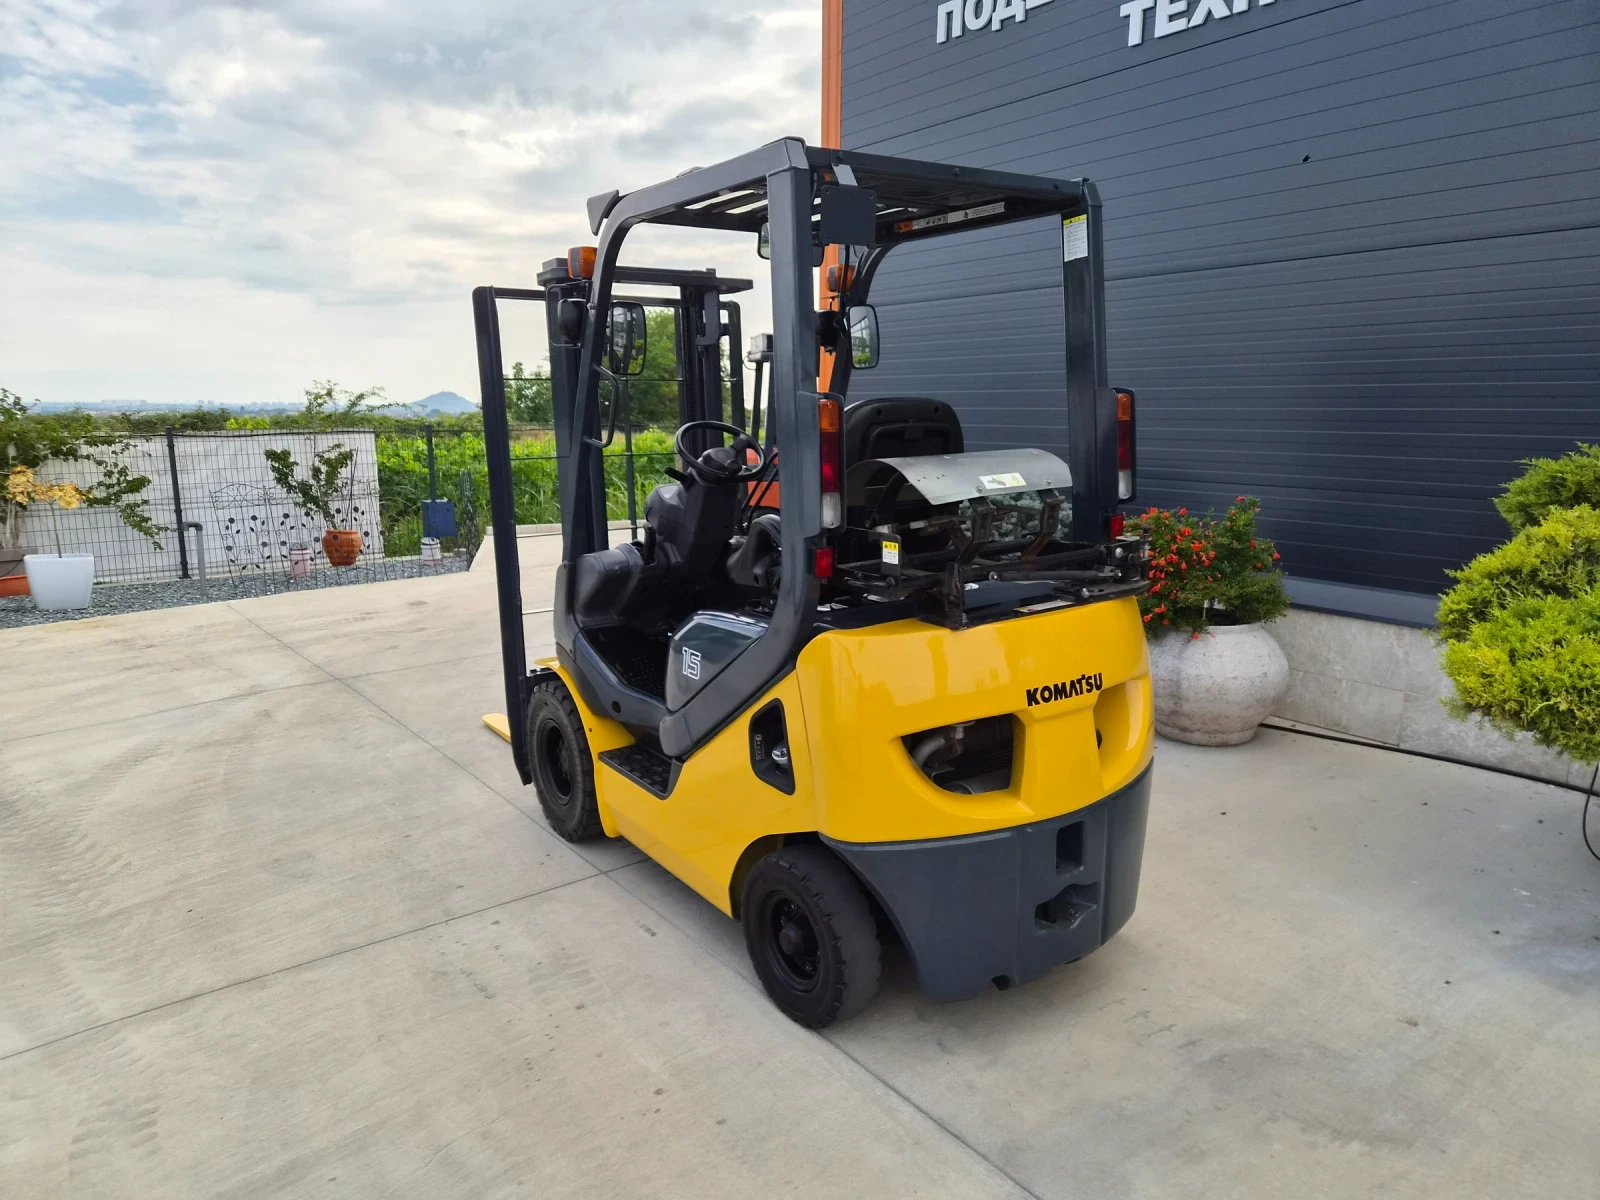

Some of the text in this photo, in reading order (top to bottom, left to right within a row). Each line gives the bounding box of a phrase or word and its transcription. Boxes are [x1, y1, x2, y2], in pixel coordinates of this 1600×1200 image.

[936, 0, 1054, 44] ПОД
[682, 646, 702, 680] 15
[1025, 672, 1103, 707] KOMATSU
